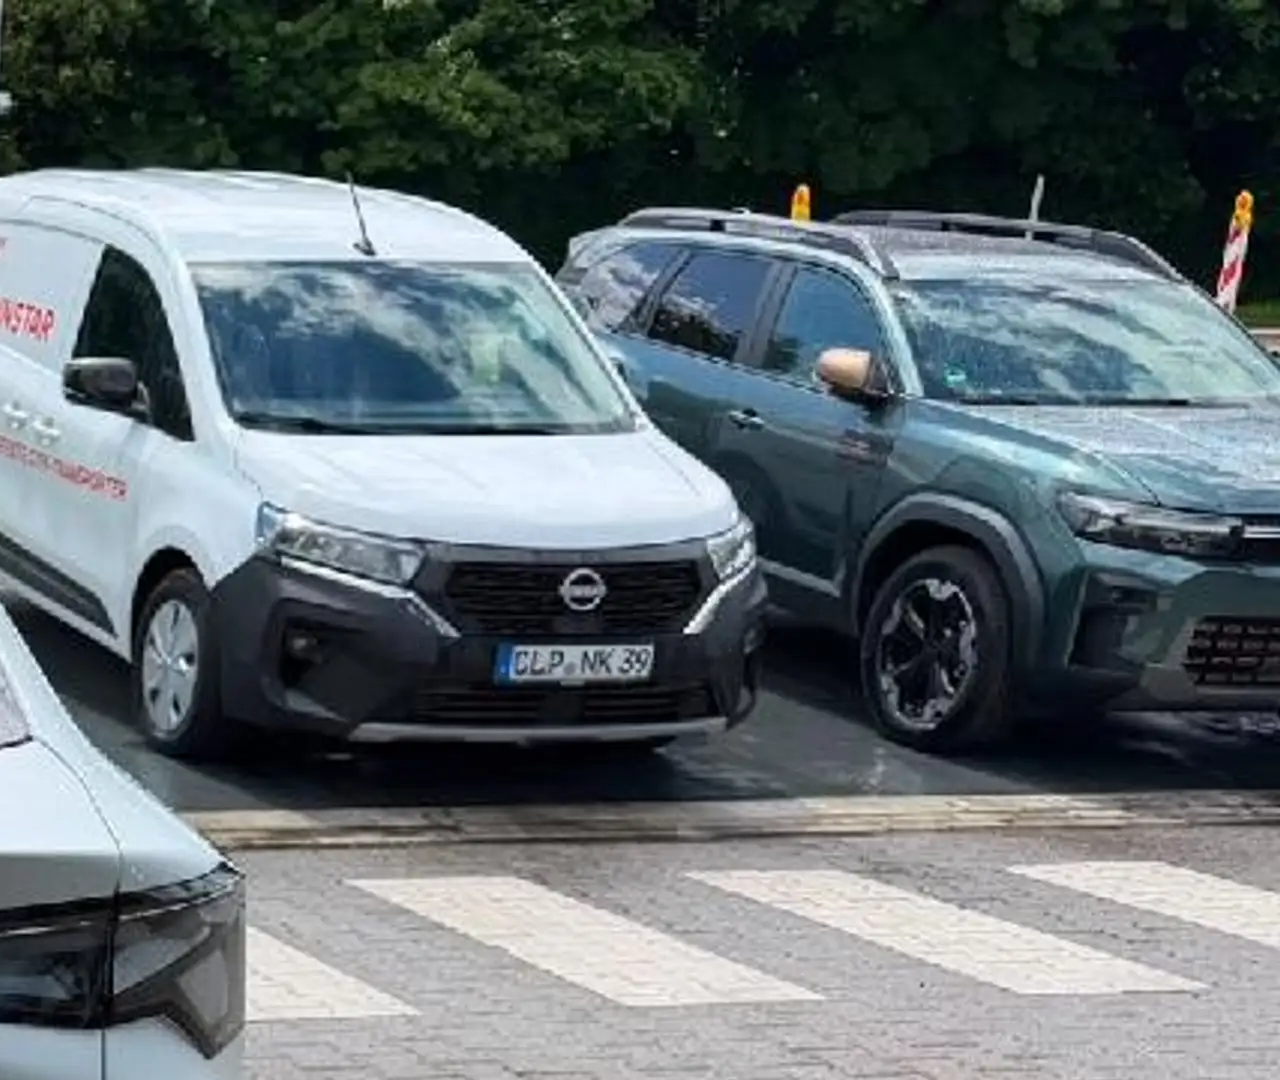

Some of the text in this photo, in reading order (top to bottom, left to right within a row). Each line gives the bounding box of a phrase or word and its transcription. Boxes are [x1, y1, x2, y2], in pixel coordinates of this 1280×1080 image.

[514, 647, 652, 676] CLP NK 39
